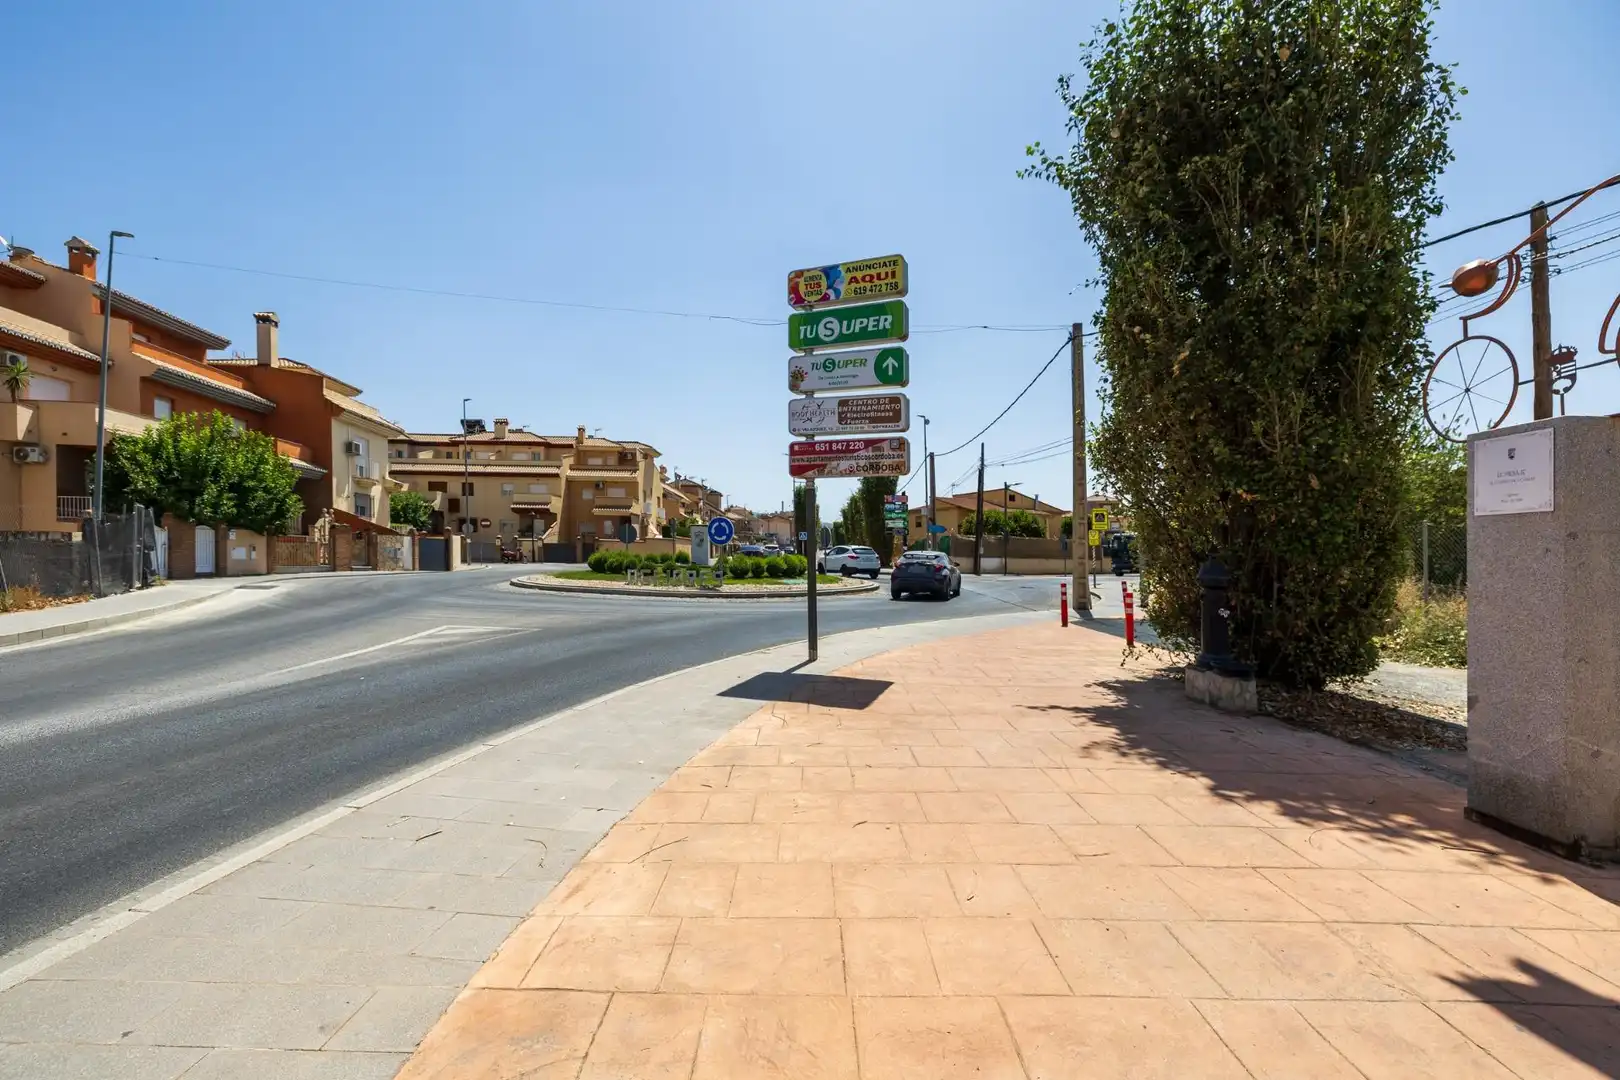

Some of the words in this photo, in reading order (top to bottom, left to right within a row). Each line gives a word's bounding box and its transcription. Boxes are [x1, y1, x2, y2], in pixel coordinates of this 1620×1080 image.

[804, 281, 822, 290] TUS
[853, 286, 867, 296] 619
[869, 284, 882, 294] 472
[885, 281, 899, 292] 758
[803, 289, 823, 298] VENTAS
[838, 403, 901, 412] ENTRENAMIENTO
[815, 443, 829, 451] 651
[832, 442, 846, 451] 847
[849, 441, 865, 450] 220
